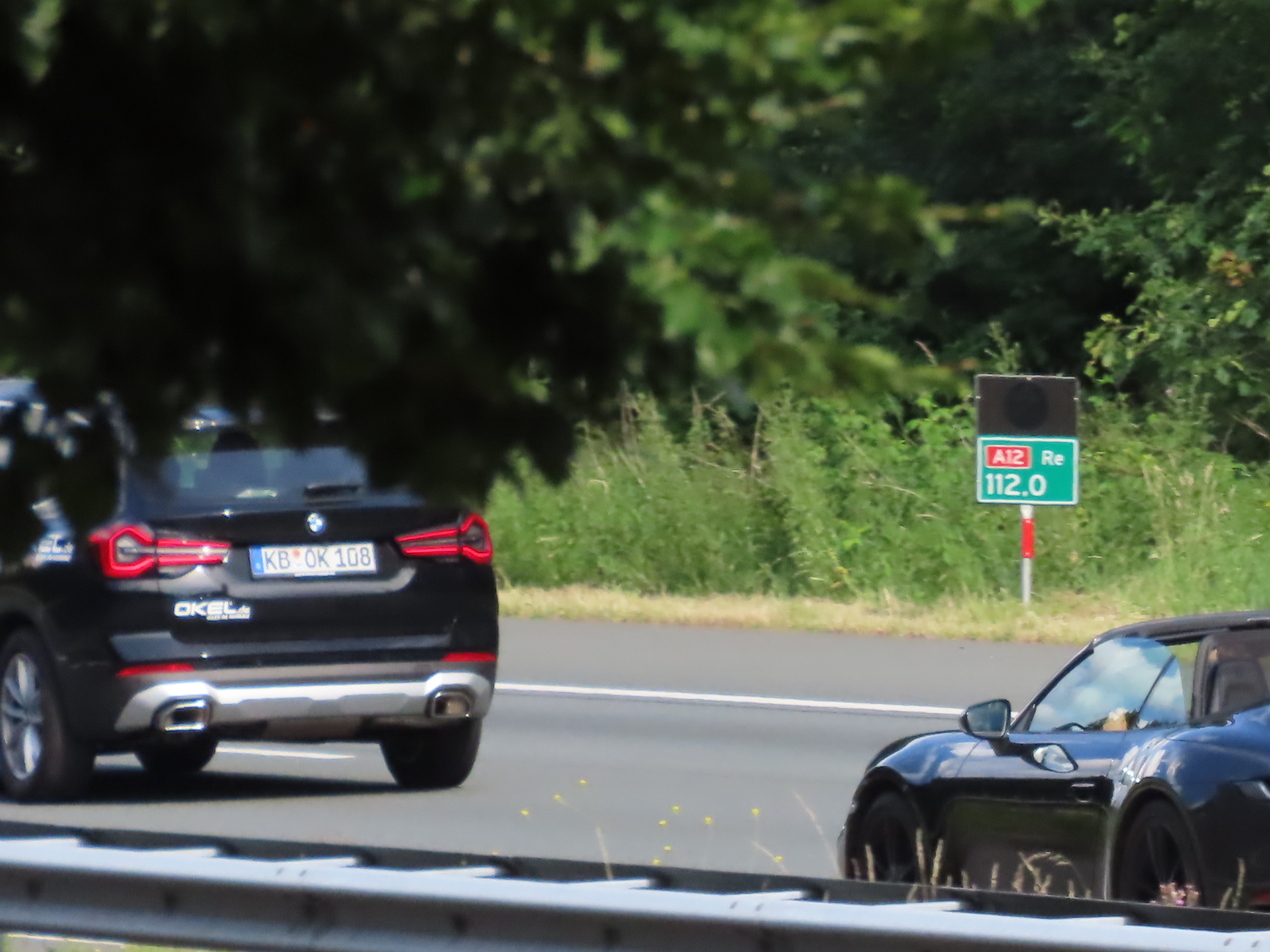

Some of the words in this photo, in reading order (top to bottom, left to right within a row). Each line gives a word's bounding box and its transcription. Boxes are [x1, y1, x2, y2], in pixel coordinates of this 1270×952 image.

[992, 449, 1025, 465] A12
[1041, 450, 1065, 466] Re
[985, 473, 1047, 497] 112.0
[264, 550, 290, 569] KB
[304, 548, 330, 568] OK
[334, 547, 371, 567] 108
